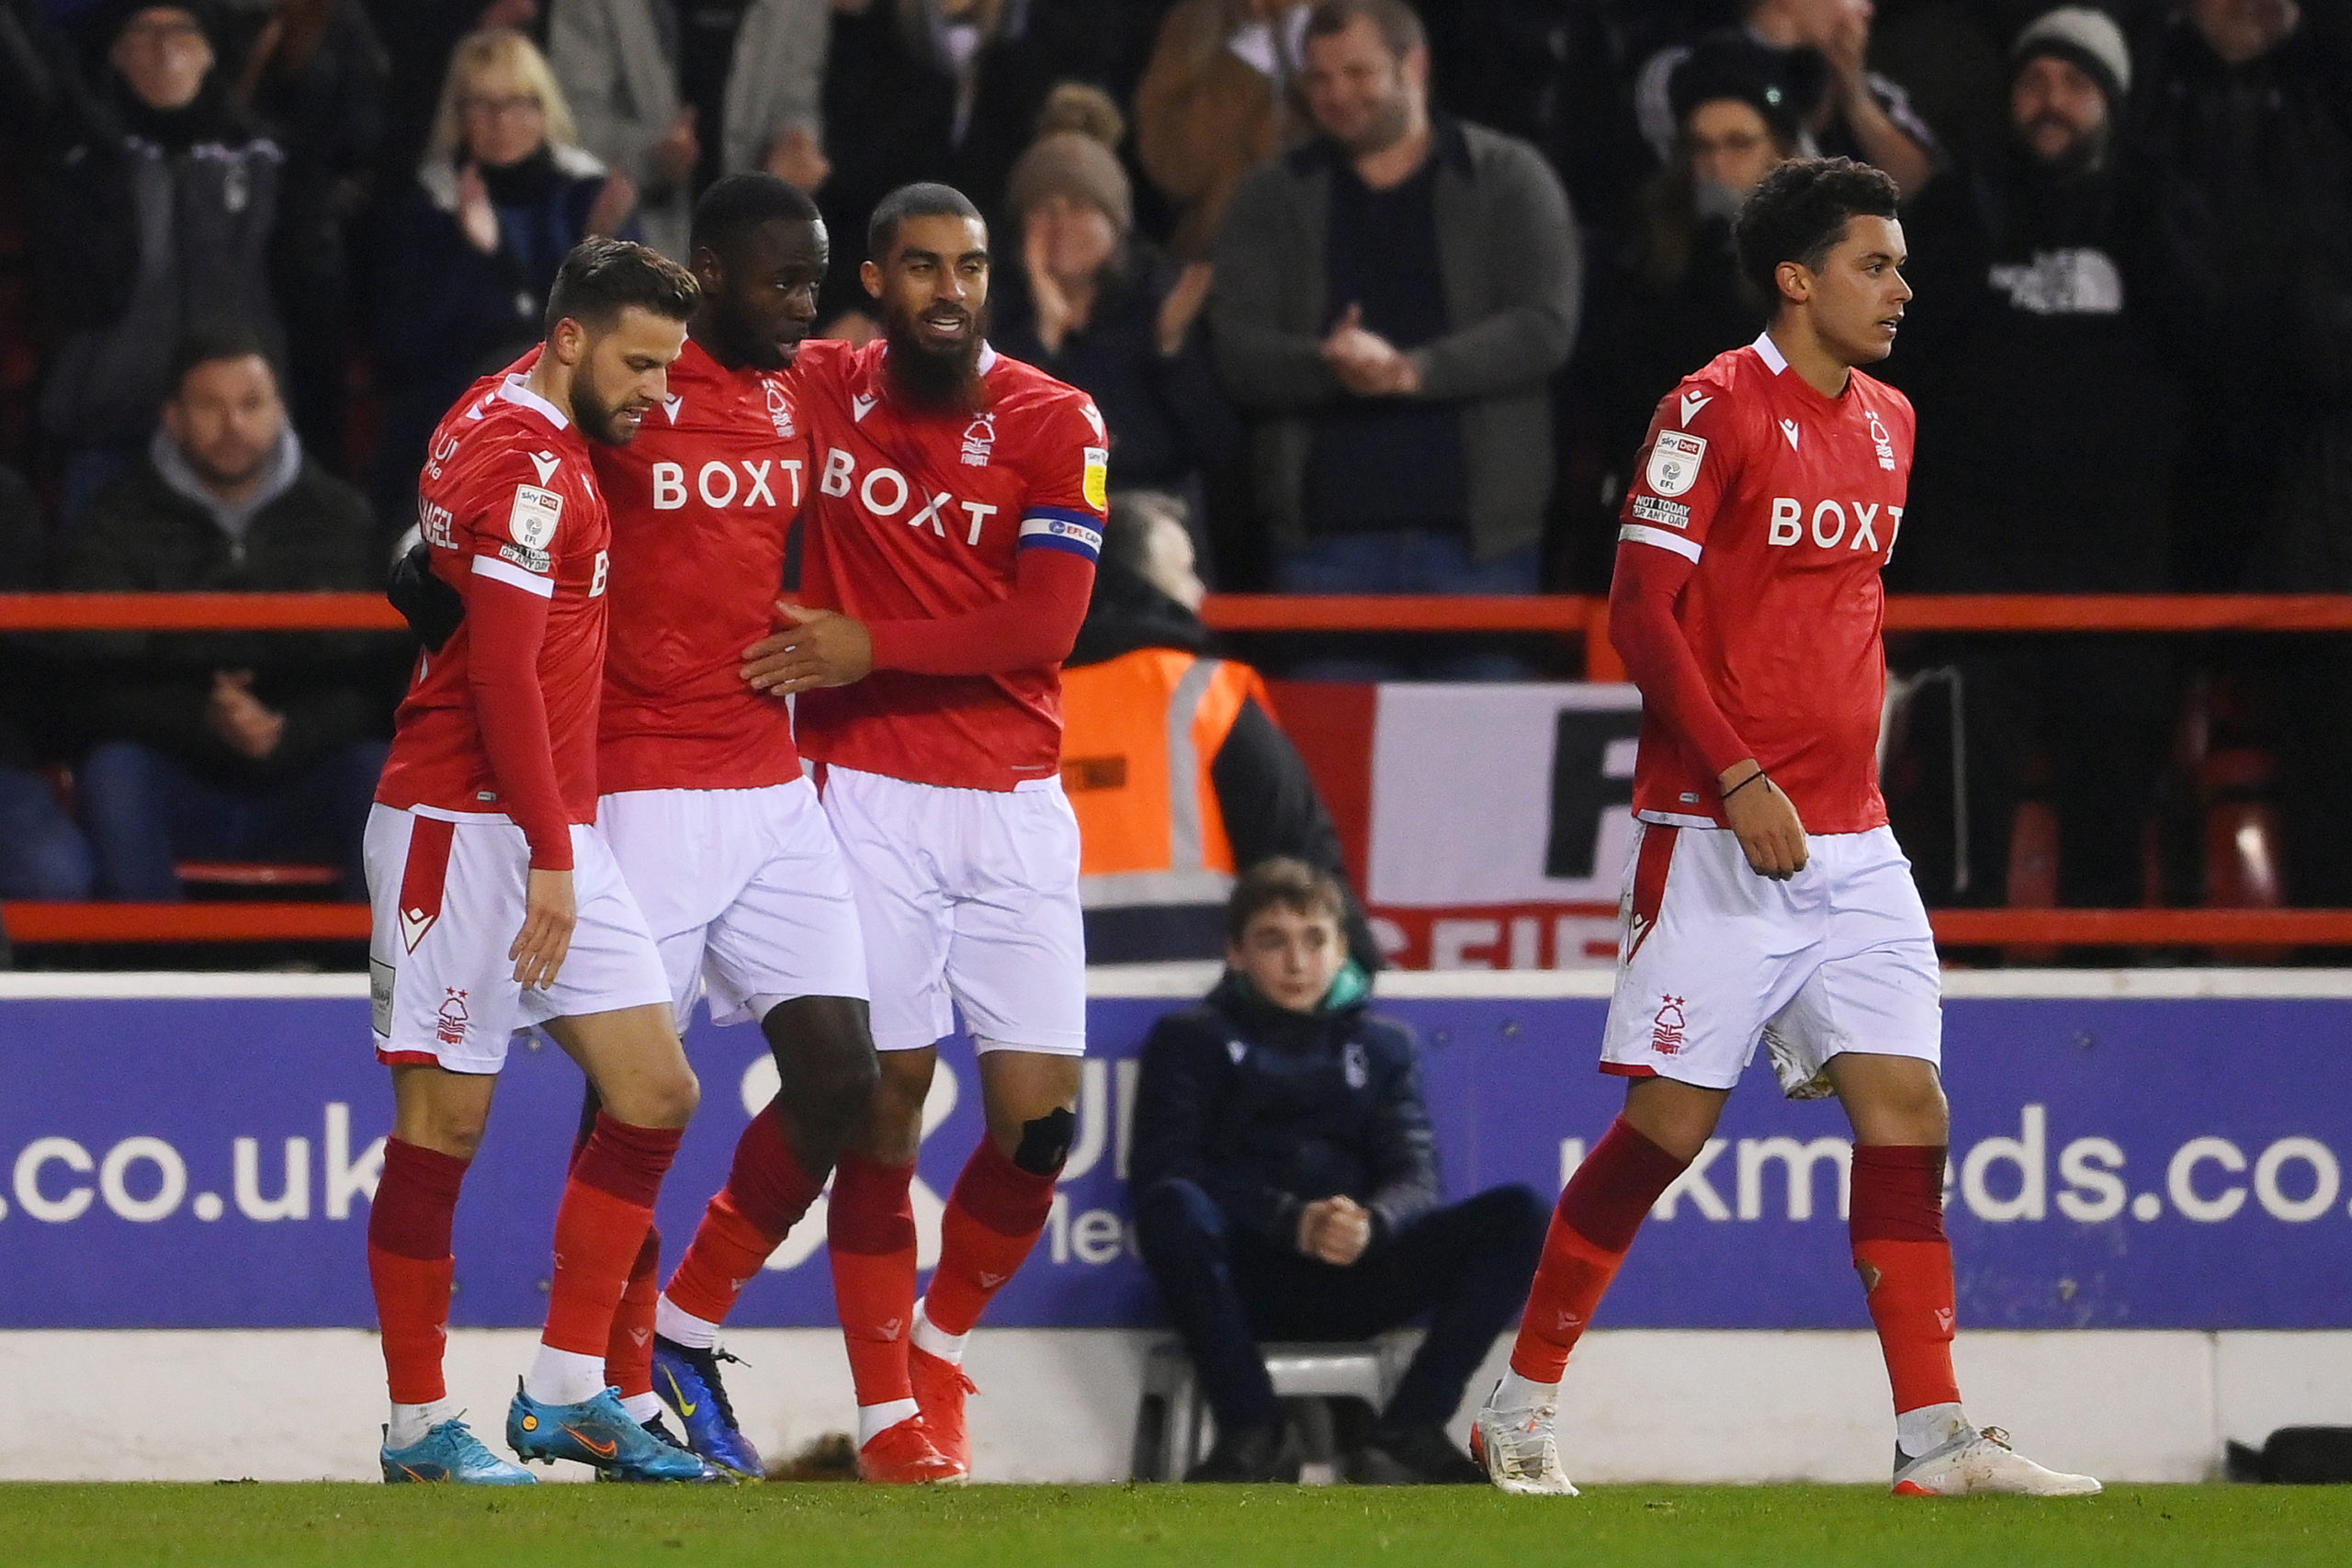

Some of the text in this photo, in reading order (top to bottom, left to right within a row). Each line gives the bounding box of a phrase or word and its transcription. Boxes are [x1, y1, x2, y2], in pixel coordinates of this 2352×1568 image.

[1661, 436, 1698, 453] sky bet
[653, 459, 803, 510] BOXT
[1659, 479, 1675, 490] EFL
[820, 447, 998, 546] BOXT
[1635, 494, 1690, 516] NOT TODAY
[1634, 505, 1687, 526] OR ANY DAY
[524, 534, 537, 546] EFL
[1067, 525, 1083, 537] EFL
[501, 547, 550, 570] OR ANY DAY
[0, 1102, 388, 1224] co.uk
